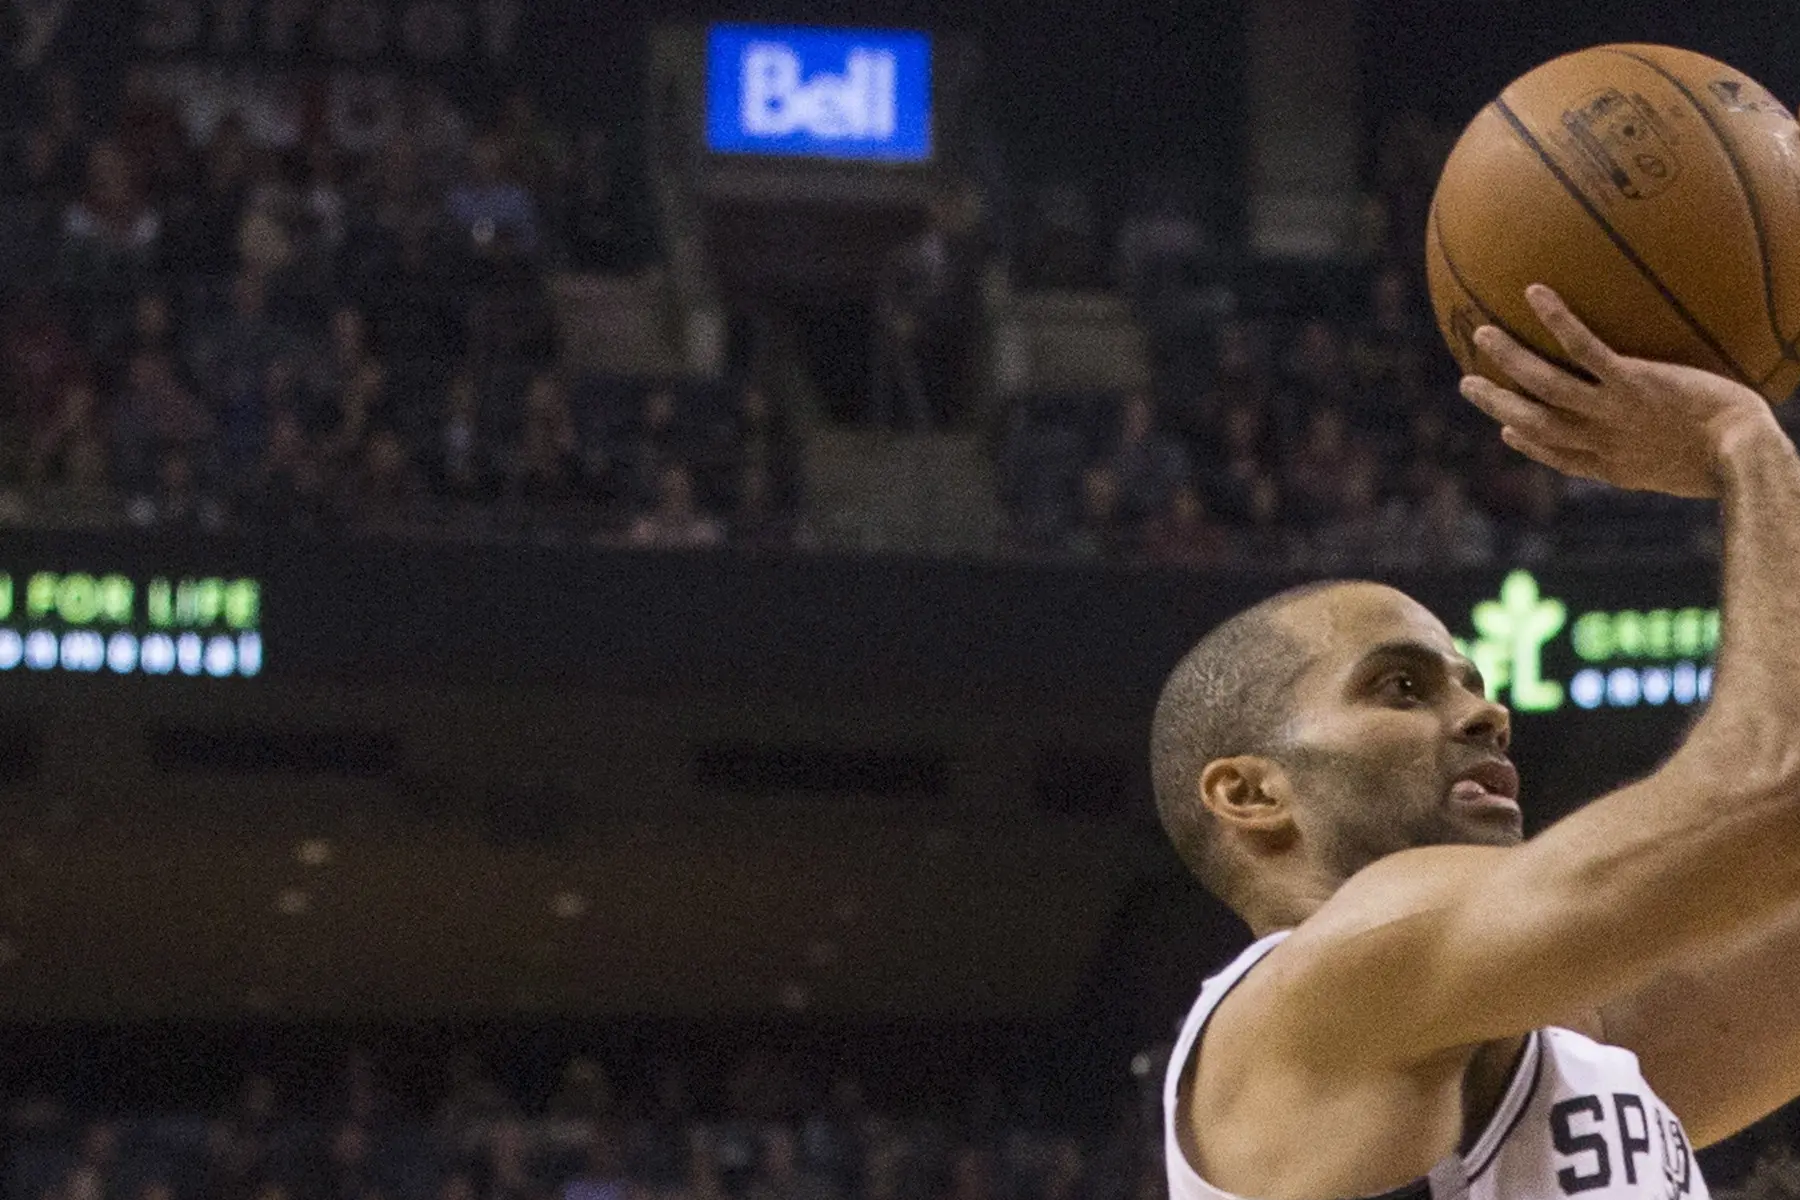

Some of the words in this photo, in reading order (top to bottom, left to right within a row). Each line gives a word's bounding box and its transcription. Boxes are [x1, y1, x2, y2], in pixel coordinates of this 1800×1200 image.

[739, 42, 898, 138] Bell
[148, 575, 260, 628] LIFE
[1549, 1092, 1693, 1197] SPU
